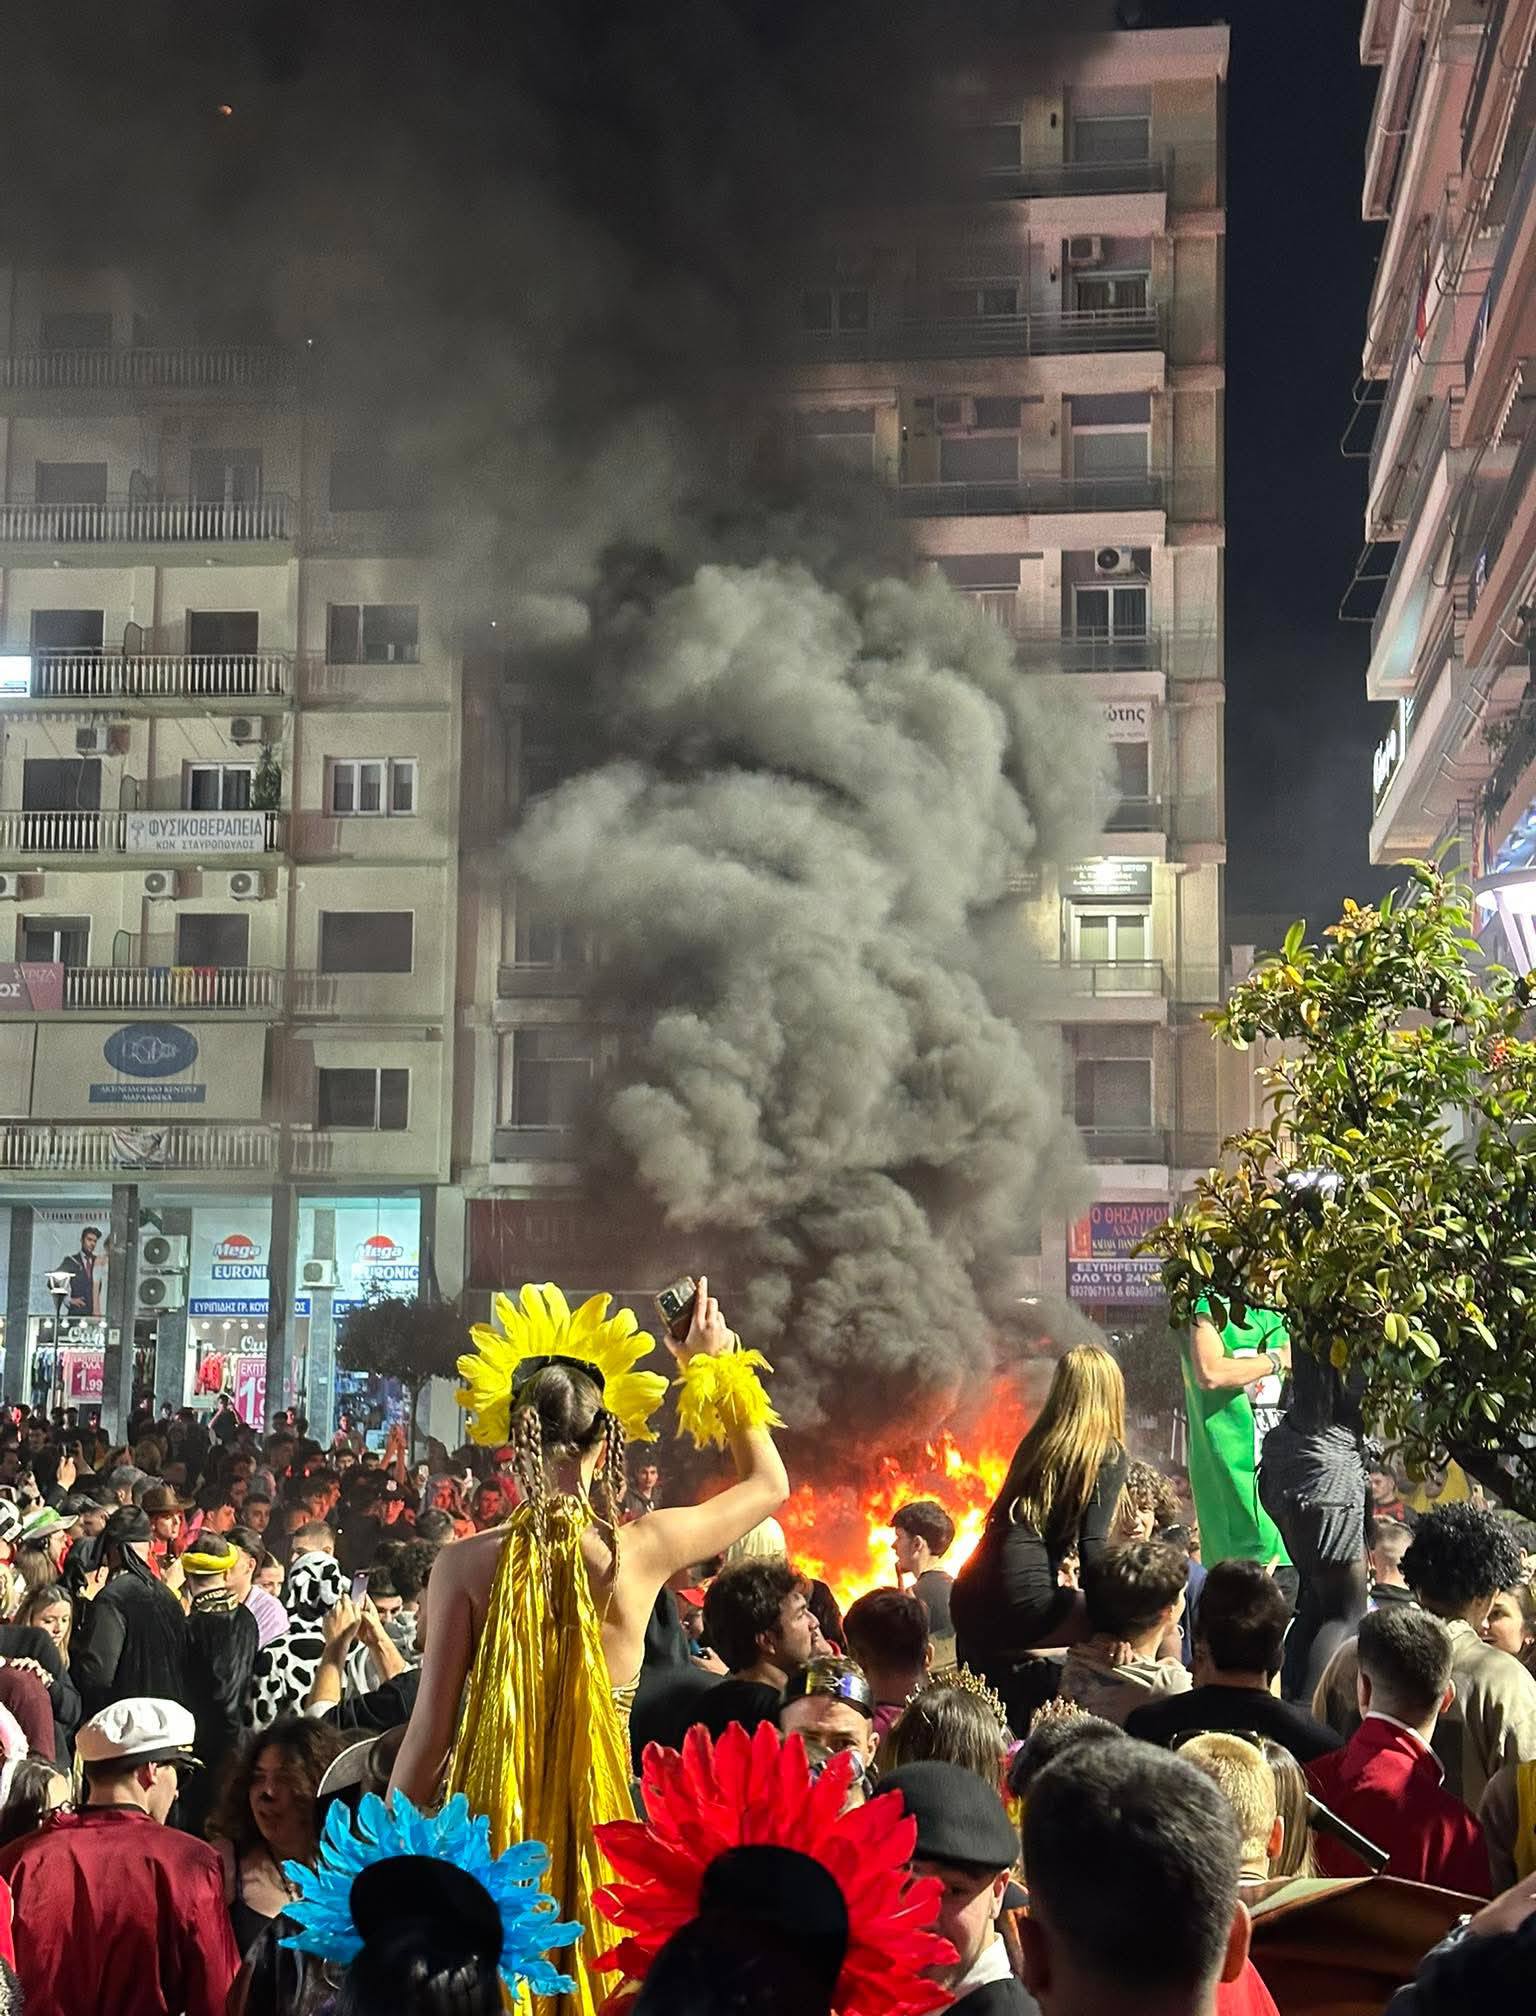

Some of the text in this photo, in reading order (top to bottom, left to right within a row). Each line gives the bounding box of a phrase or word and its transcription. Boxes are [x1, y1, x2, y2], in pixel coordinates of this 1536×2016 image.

[1103, 704, 1145, 724] ώτης
[149, 817, 262, 836] ΦΥΣΙΚΟΘΕΡΑΠΕΙΑ
[156, 839, 254, 849] ΚΩΝ ΣΤΑΥΡΟΠΟΥΛΟΣ
[0, 983, 20, 998] ΟΣ
[1092, 1207, 1101, 1224] Ο
[214, 1244, 260, 1259] Mega
[357, 1245, 403, 1259] Mega
[214, 1266, 268, 1279] EURONI
[358, 1266, 419, 1280] URONIC
[1072, 1273, 1101, 1283] ΟΛΟ
[1104, 1273, 1122, 1283] ΤΟ
[194, 1302, 236, 1312] ΕΥΡΙΠΙΔΗΣ
[241, 1363, 266, 1375] ΕΚΠΤ
[77, 1368, 103, 1391] 1.99
